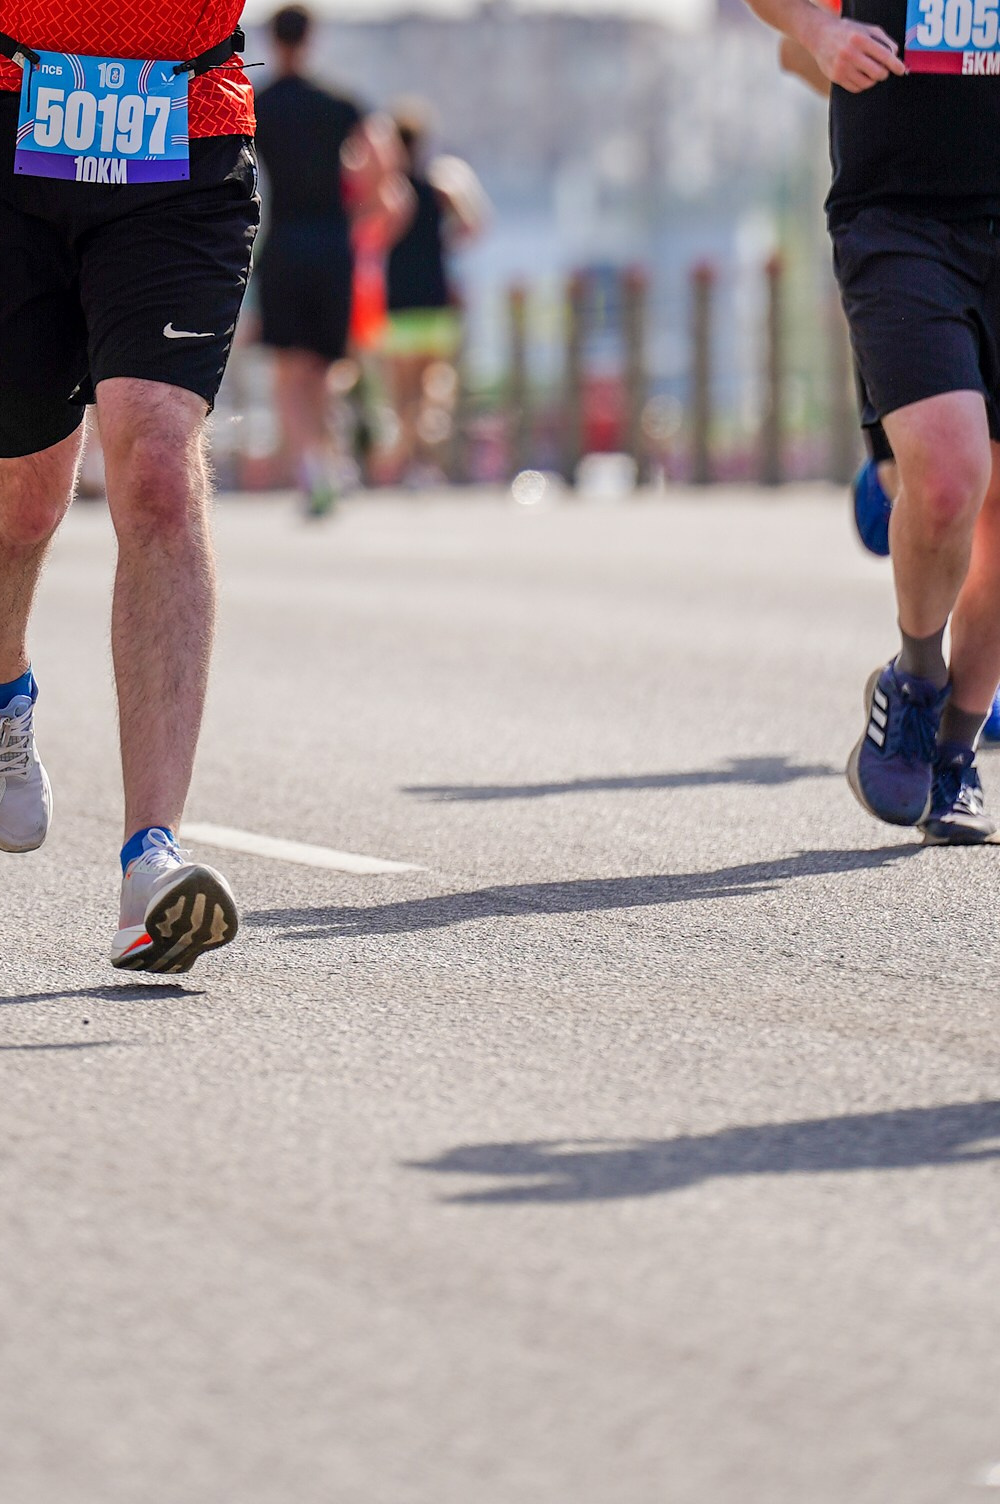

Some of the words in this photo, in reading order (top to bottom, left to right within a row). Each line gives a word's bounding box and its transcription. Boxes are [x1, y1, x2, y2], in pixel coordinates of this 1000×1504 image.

[41, 64, 63, 76] ПСБ
[97, 62, 125, 89] 10
[962, 50, 1000, 76] 5KM
[33, 86, 172, 155] 50197
[74, 155, 128, 185] 10KM
